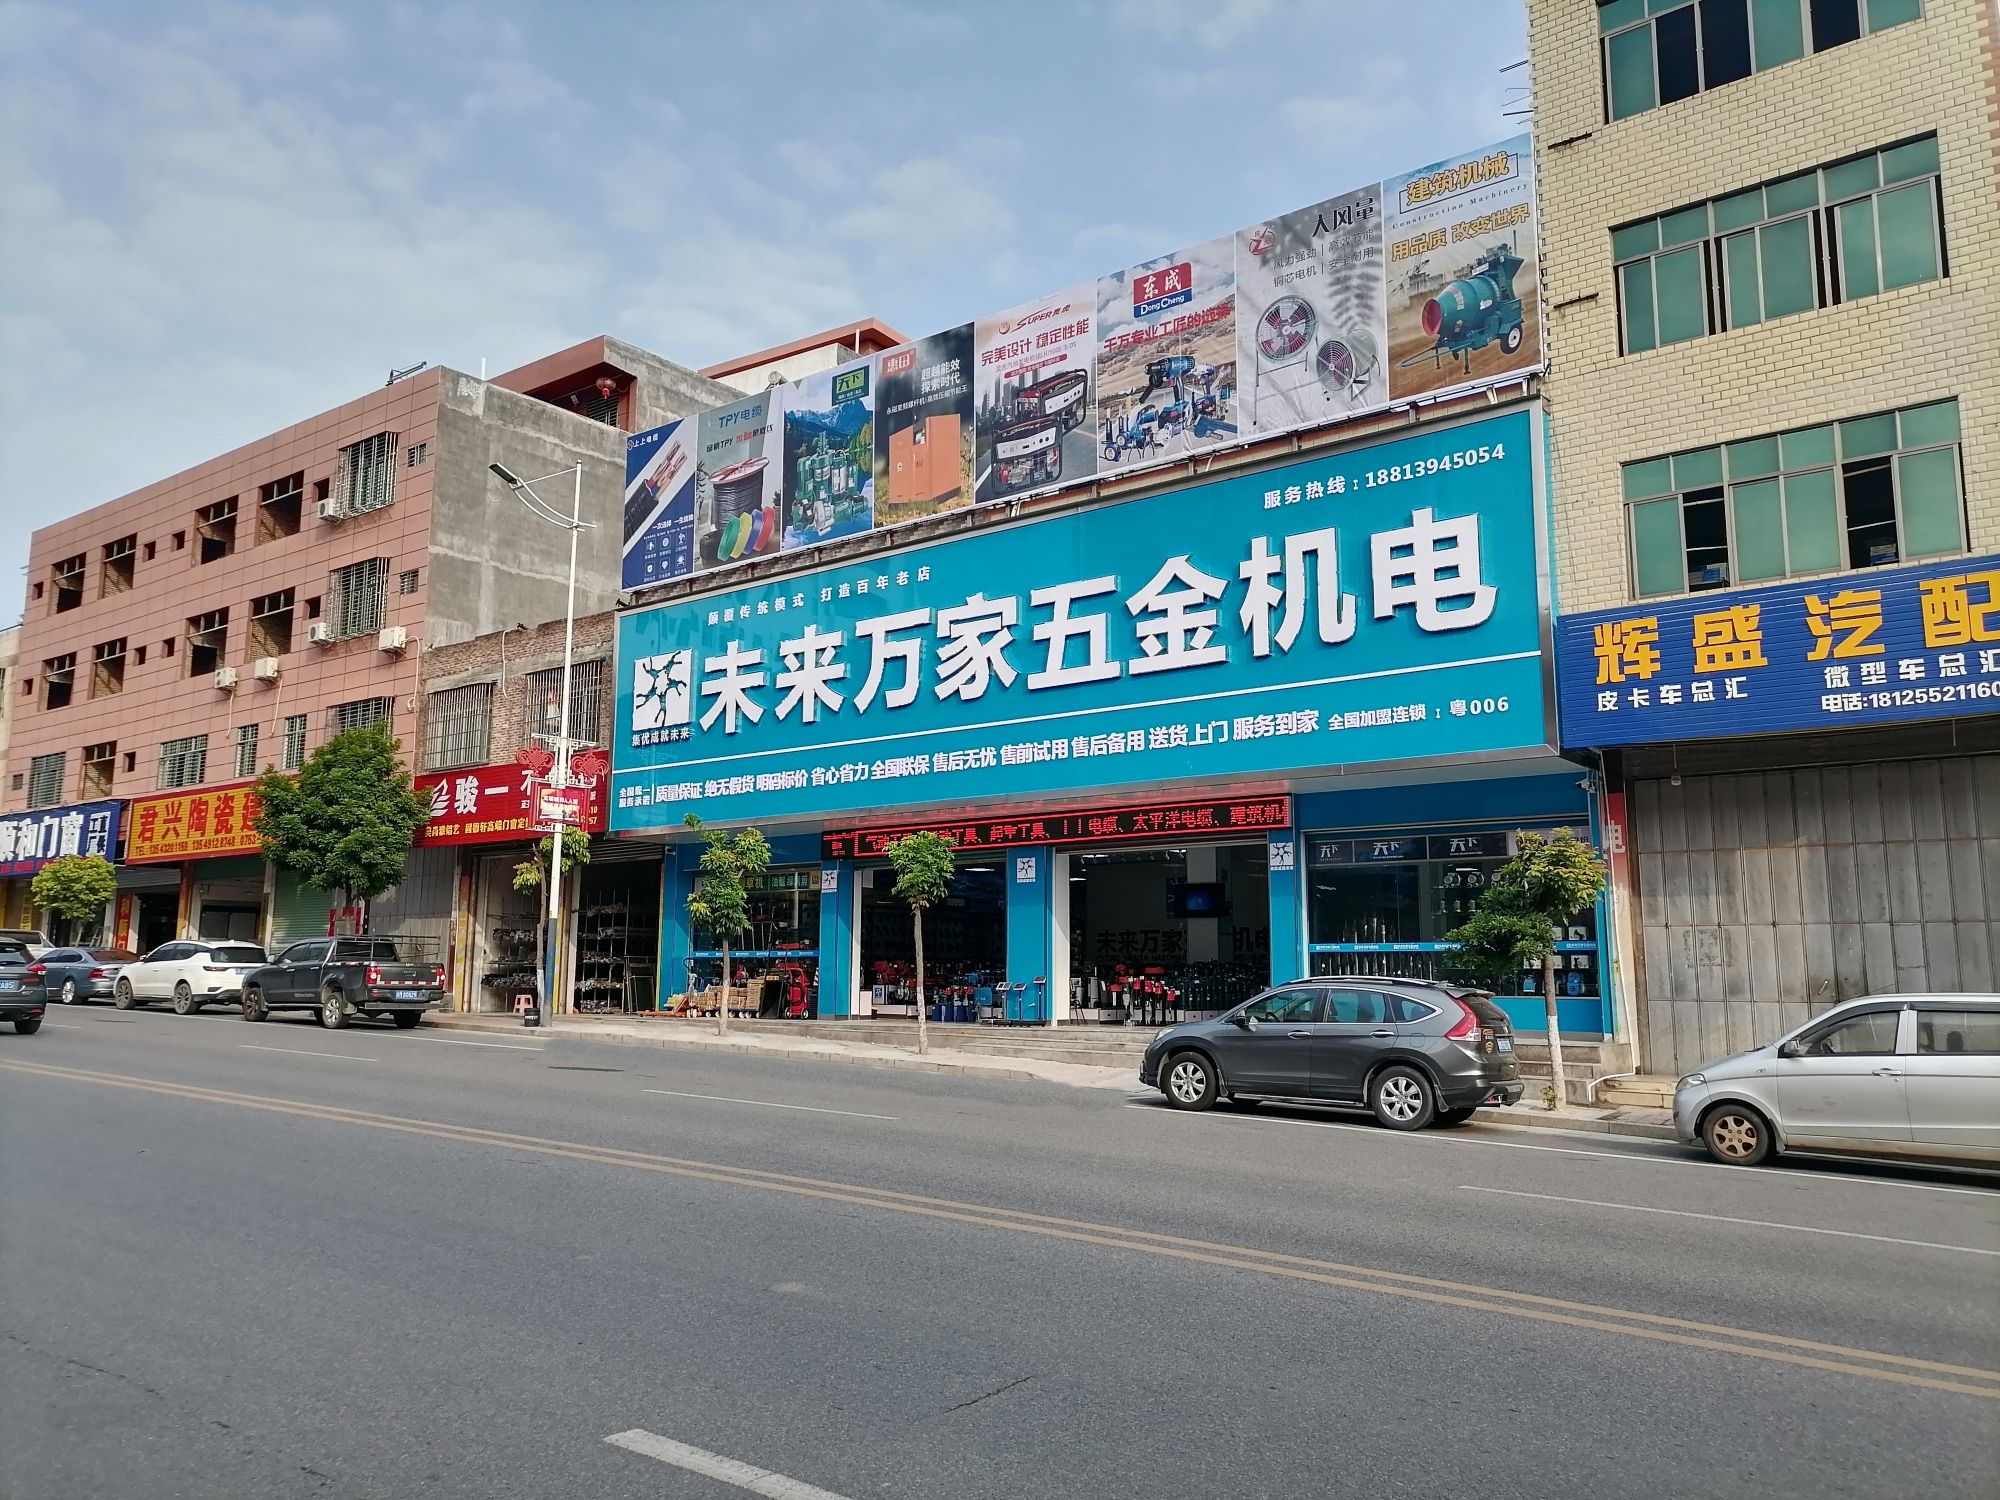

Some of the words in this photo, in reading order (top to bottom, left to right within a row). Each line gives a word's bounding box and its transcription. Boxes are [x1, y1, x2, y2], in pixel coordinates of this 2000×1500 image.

[1406, 151, 1509, 206] 建筑机械
[1311, 197, 1375, 238] 大风量
[1392, 203, 1464, 229] Construction
[1469, 184, 1528, 204] Machinery
[1391, 227, 1447, 262] 用品质
[1451, 203, 1530, 243] 改变世界
[1143, 269, 1182, 299] 东成
[1273, 265, 1317, 288] 铜芯电机
[1328, 247, 1374, 271] 安全耐用
[981, 338, 1032, 367] 完美设计
[1036, 317, 1089, 349] 稳定性能
[838, 372, 861, 391] 天下
[921, 358, 960, 381] 超越能效
[921, 371, 960, 394] 探索时代
[718, 405, 762, 428] TPY电缆
[820, 566, 931, 602] 打造百年老店
[700, 506, 1498, 734] 未来万家五金机电
[1594, 569, 2000, 685] 辉盛汽配
[1824, 648, 2000, 689] 微型车总汇
[1598, 676, 1749, 711] 皮卡车总汇
[656, 782, 702, 802] 质量保证
[704, 775, 754, 798] 绝无假货
[756, 769, 808, 791] 明码标价
[810, 761, 868, 786] 省心省力
[870, 754, 930, 781] 全国联保
[932, 746, 996, 773] 售后无忧
[1000, 738, 1068, 767] 售前试用
[1071, 729, 1145, 758] 售后备用
[1149, 720, 1229, 750] 送货上门
[1232, 709, 1319, 741] 服务到家
[1229, 803, 1286, 825] 建筑机
[1320, 844, 1340, 858] 天下
[1373, 841, 1401, 856] 天下
[1450, 837, 1478, 852] 天下
